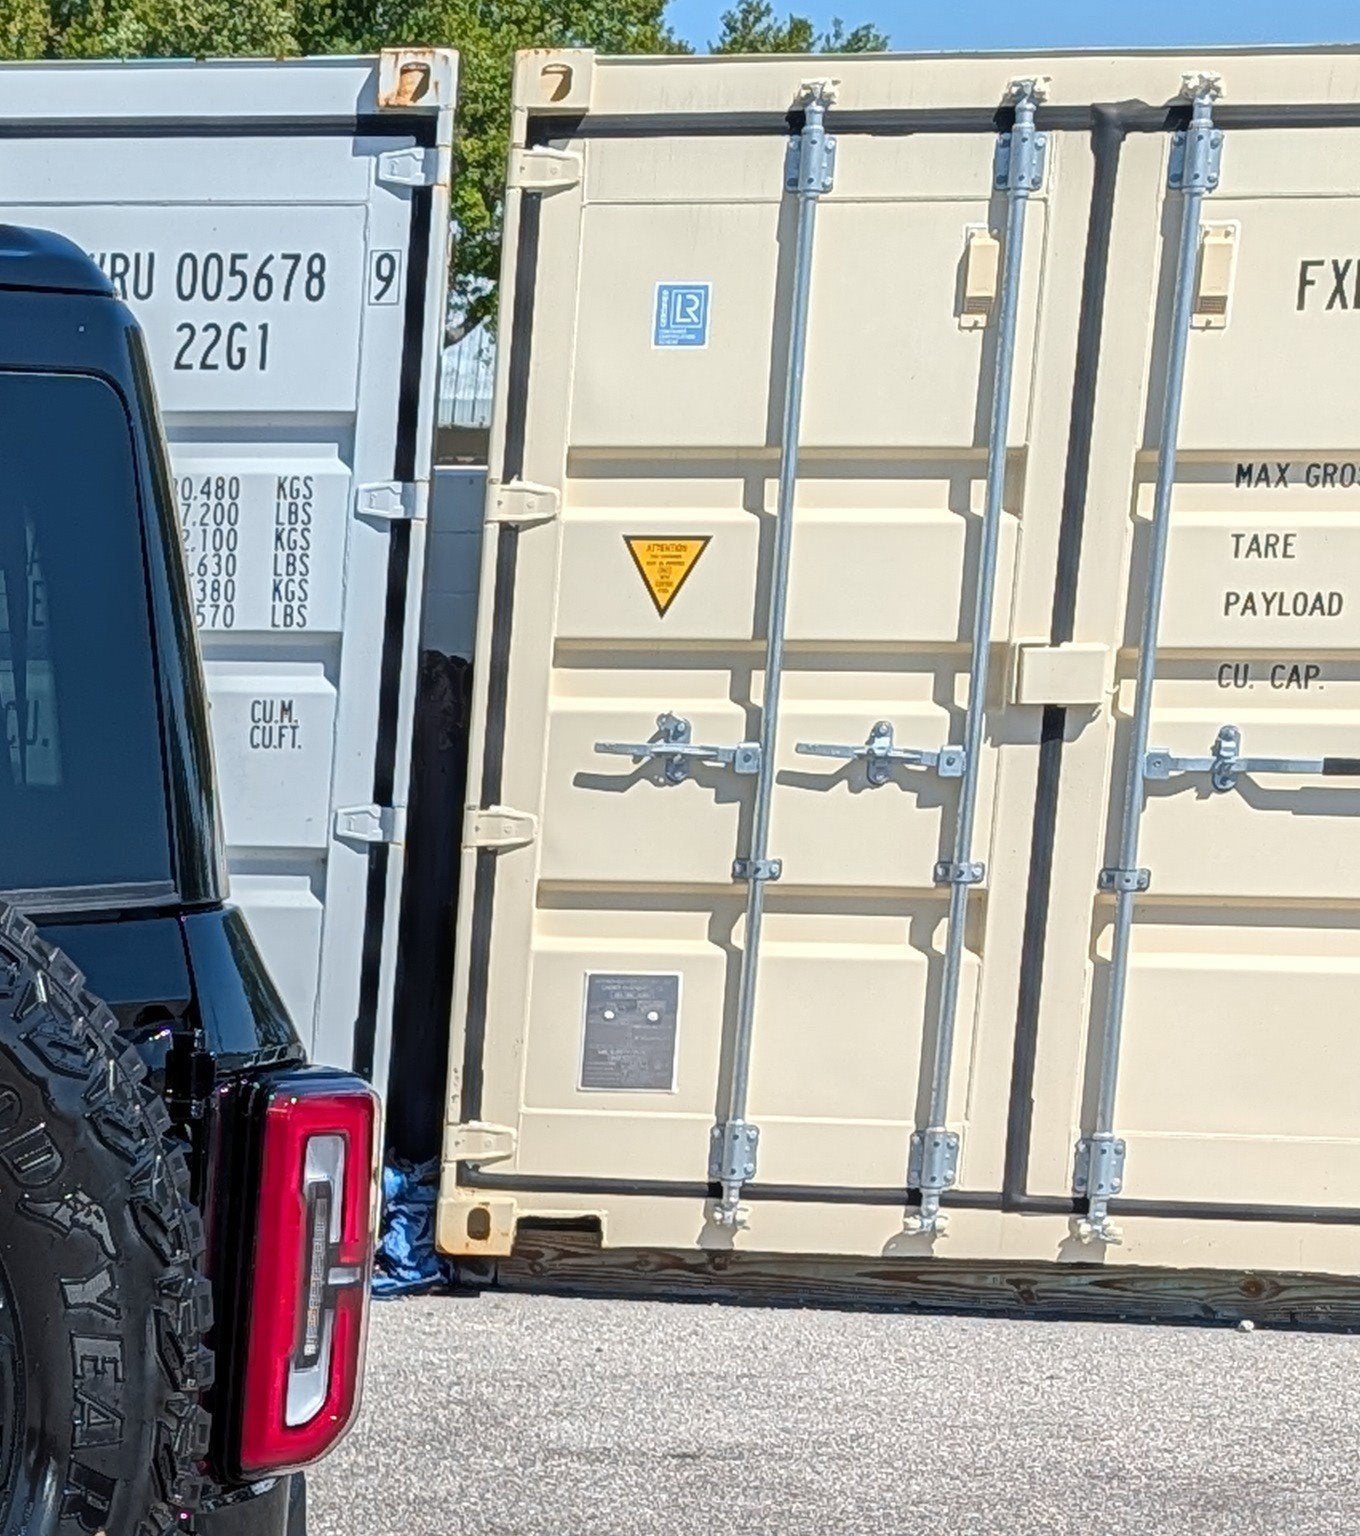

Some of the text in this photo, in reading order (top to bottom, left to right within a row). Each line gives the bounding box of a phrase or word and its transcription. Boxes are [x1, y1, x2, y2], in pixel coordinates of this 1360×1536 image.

[176, 252, 327, 302] 005678
[374, 252, 397, 302] 9
[1296, 258, 1360, 311] FX
[173, 321, 271, 371] 22G1
[1235, 462, 1360, 488] MAX GRO
[276, 476, 314, 501] KGS
[275, 502, 313, 527] LBS
[274, 527, 312, 552] KGS
[1231, 533, 1297, 559] TARE
[185, 552, 310, 577] .630 LBS
[272, 578, 309, 603] KGS
[270, 604, 308, 628] LBS
[1223, 591, 1344, 617] PAYLOAD
[1217, 663, 1325, 690] CU. CAP.
